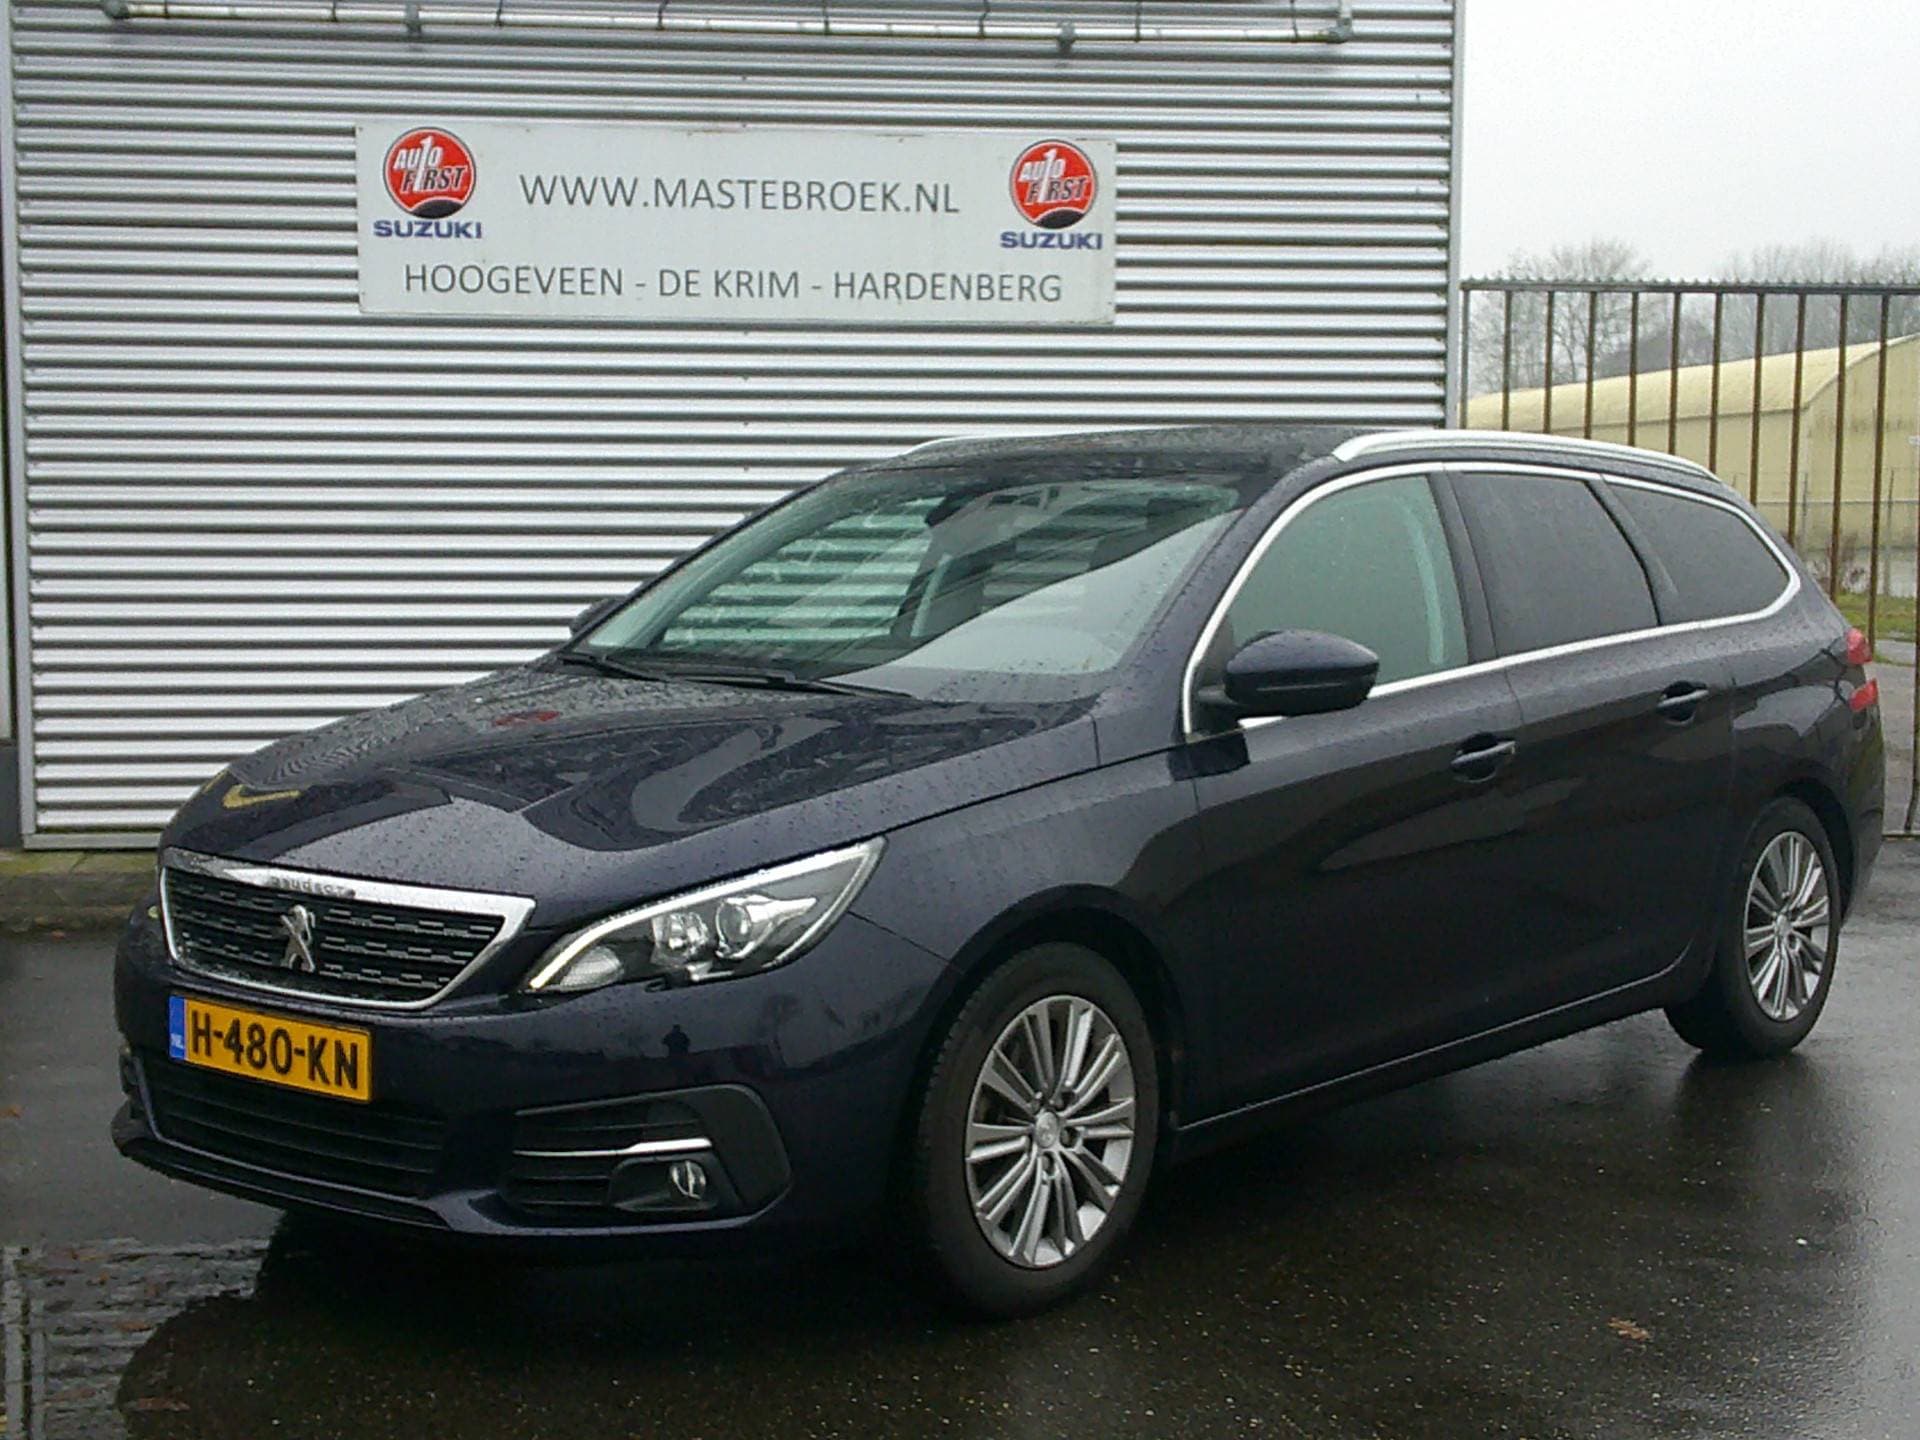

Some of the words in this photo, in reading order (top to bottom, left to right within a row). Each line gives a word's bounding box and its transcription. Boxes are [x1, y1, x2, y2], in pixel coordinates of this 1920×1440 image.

[519, 174, 960, 214] WWW.MASTEBROEK.NL
[373, 219, 482, 239] SUZUKI
[1000, 231, 1103, 251] SUZUKI
[405, 263, 623, 297] HOOGEVEEN
[659, 269, 700, 297] DE
[714, 270, 799, 298] KRIM
[834, 272, 1062, 302] HARDENBERG
[191, 1009, 358, 1090] H-480-KN
